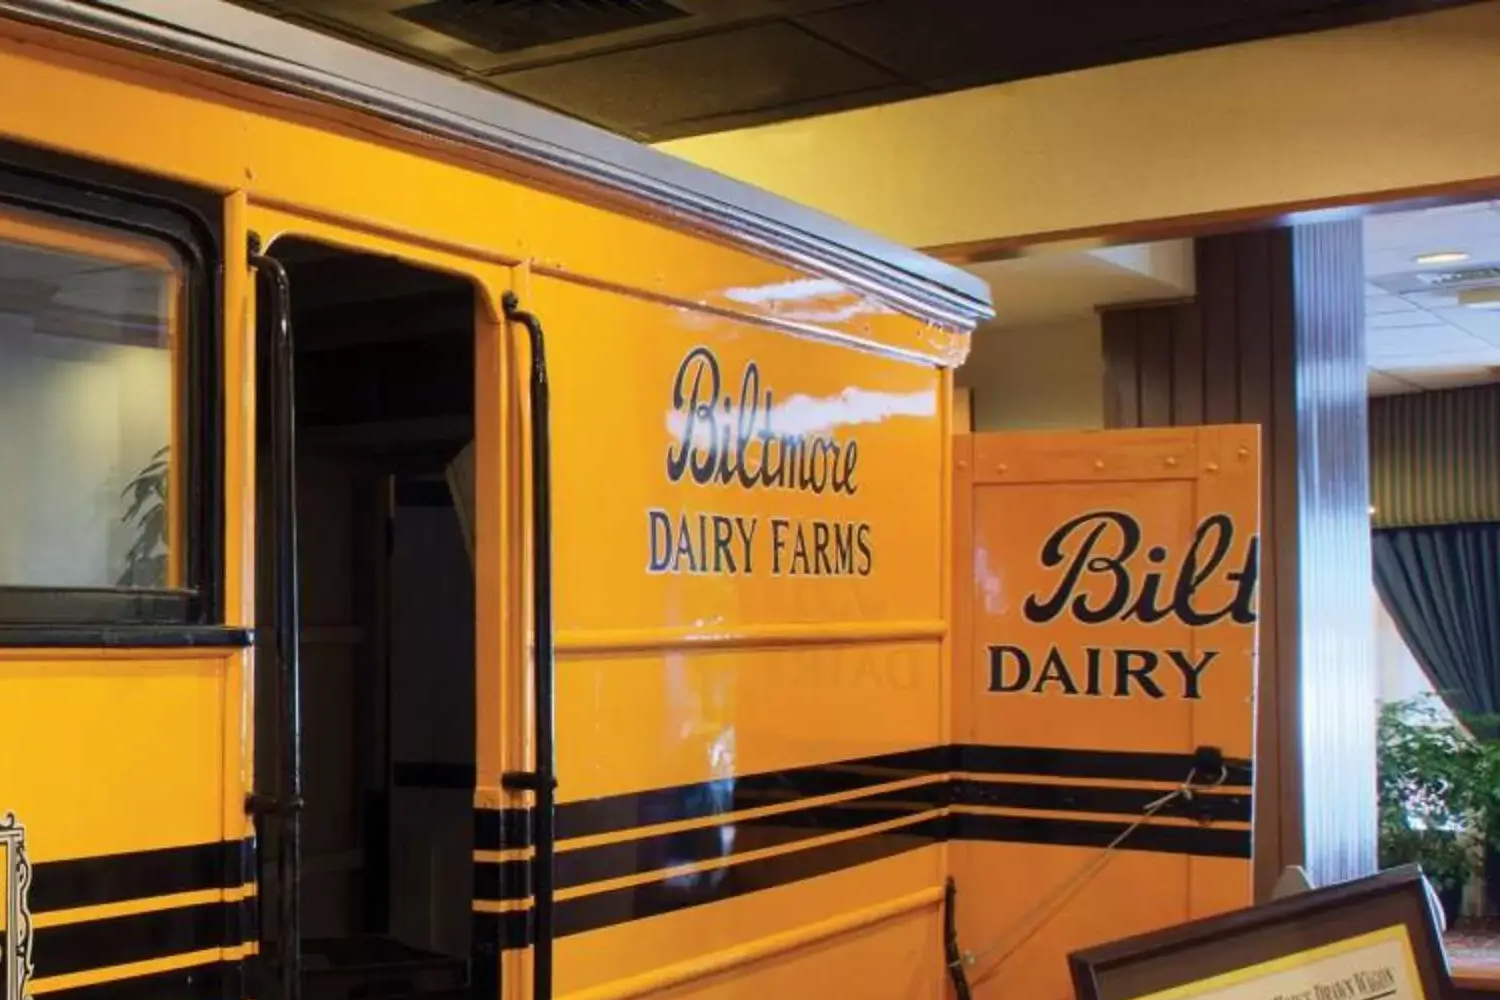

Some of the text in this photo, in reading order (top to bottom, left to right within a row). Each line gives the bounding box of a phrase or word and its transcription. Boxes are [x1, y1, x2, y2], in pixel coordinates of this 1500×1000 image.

[667, 347, 857, 495] Biltmore
[650, 511, 871, 576] DAIRY FARMS
[988, 645, 1218, 698] DAIRY
